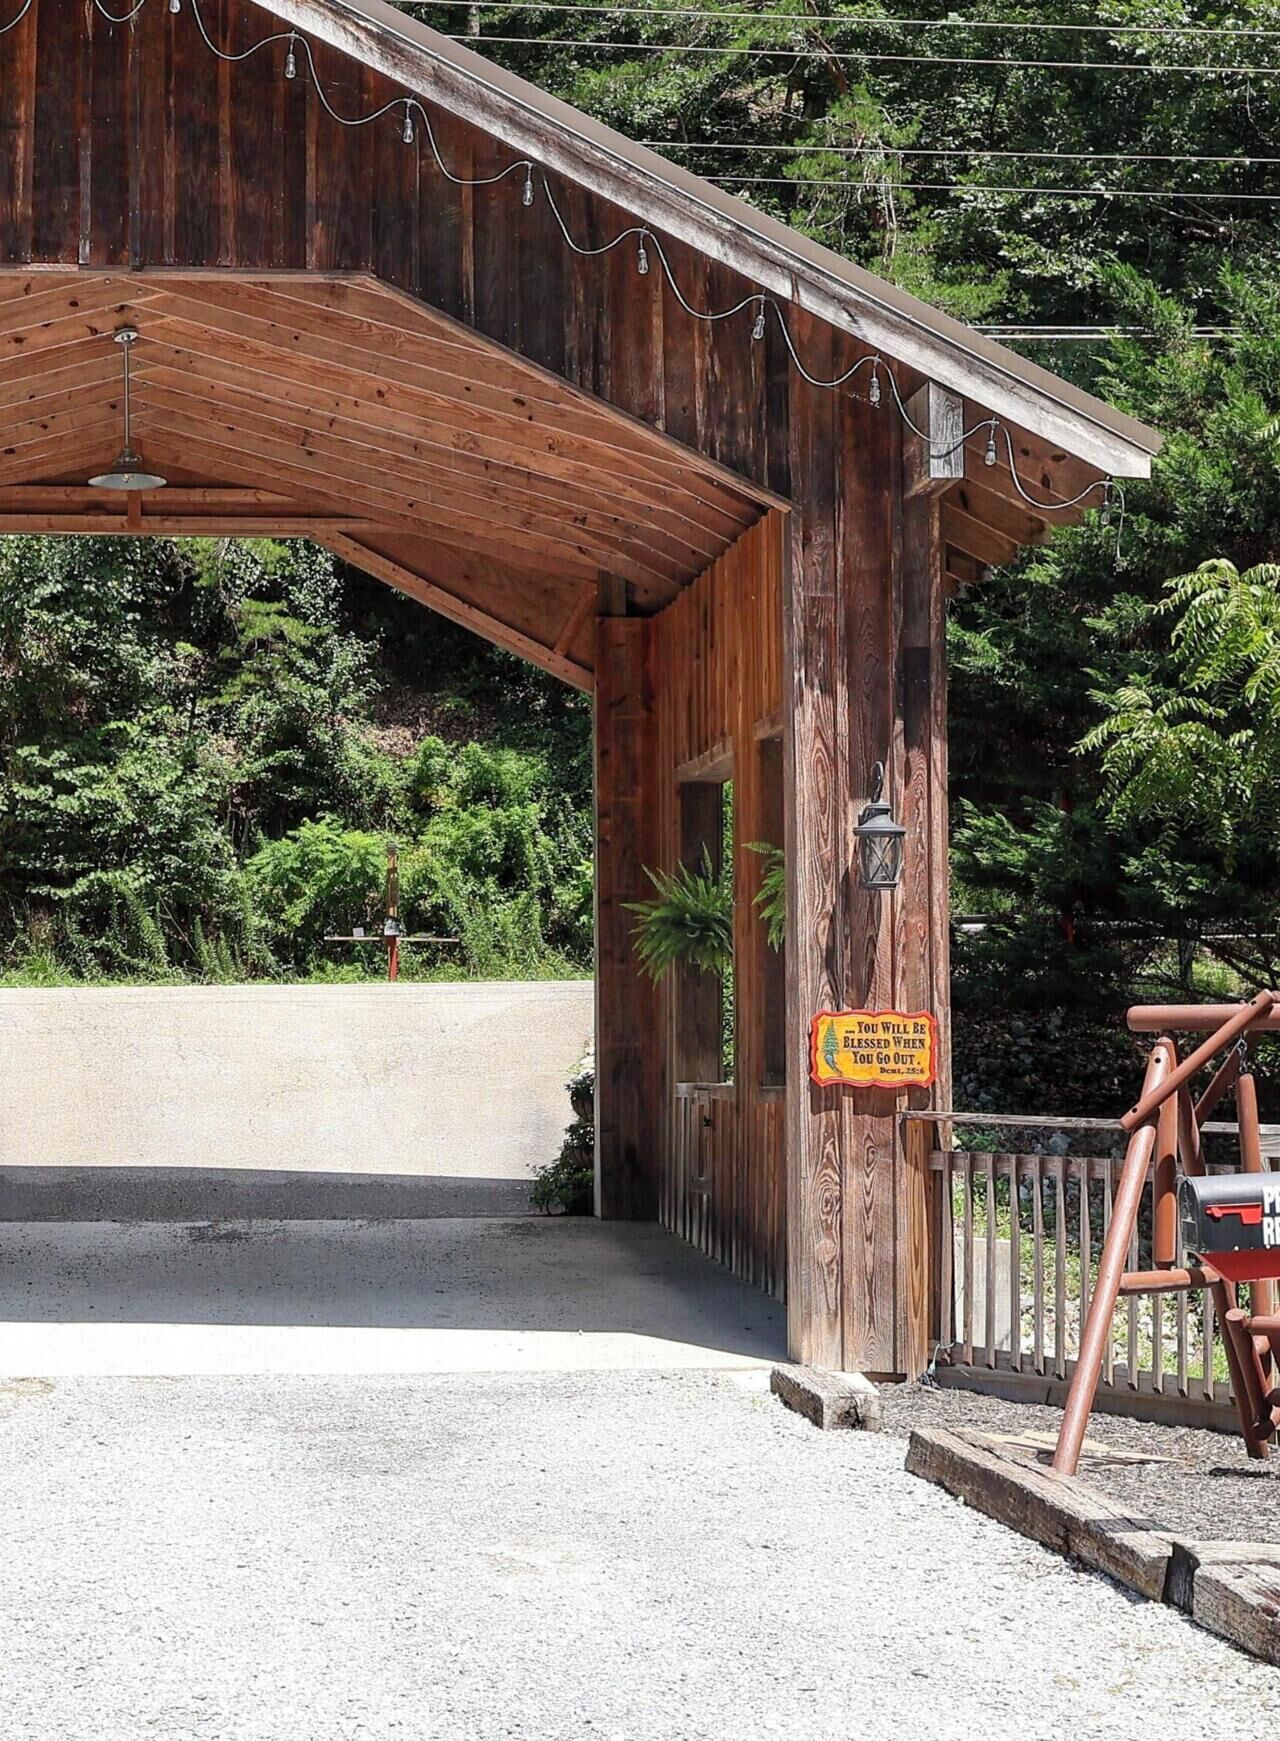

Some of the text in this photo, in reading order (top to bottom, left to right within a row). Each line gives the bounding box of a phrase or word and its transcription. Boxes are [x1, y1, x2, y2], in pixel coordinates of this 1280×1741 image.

[857, 1021, 878, 1034] YOU
[881, 1021, 909, 1034] WILL
[913, 1022, 926, 1035] BE
[843, 1036, 925, 1049] BLESSED WHEN
[852, 1051, 873, 1064] YOU
[876, 1052, 890, 1064] GO
